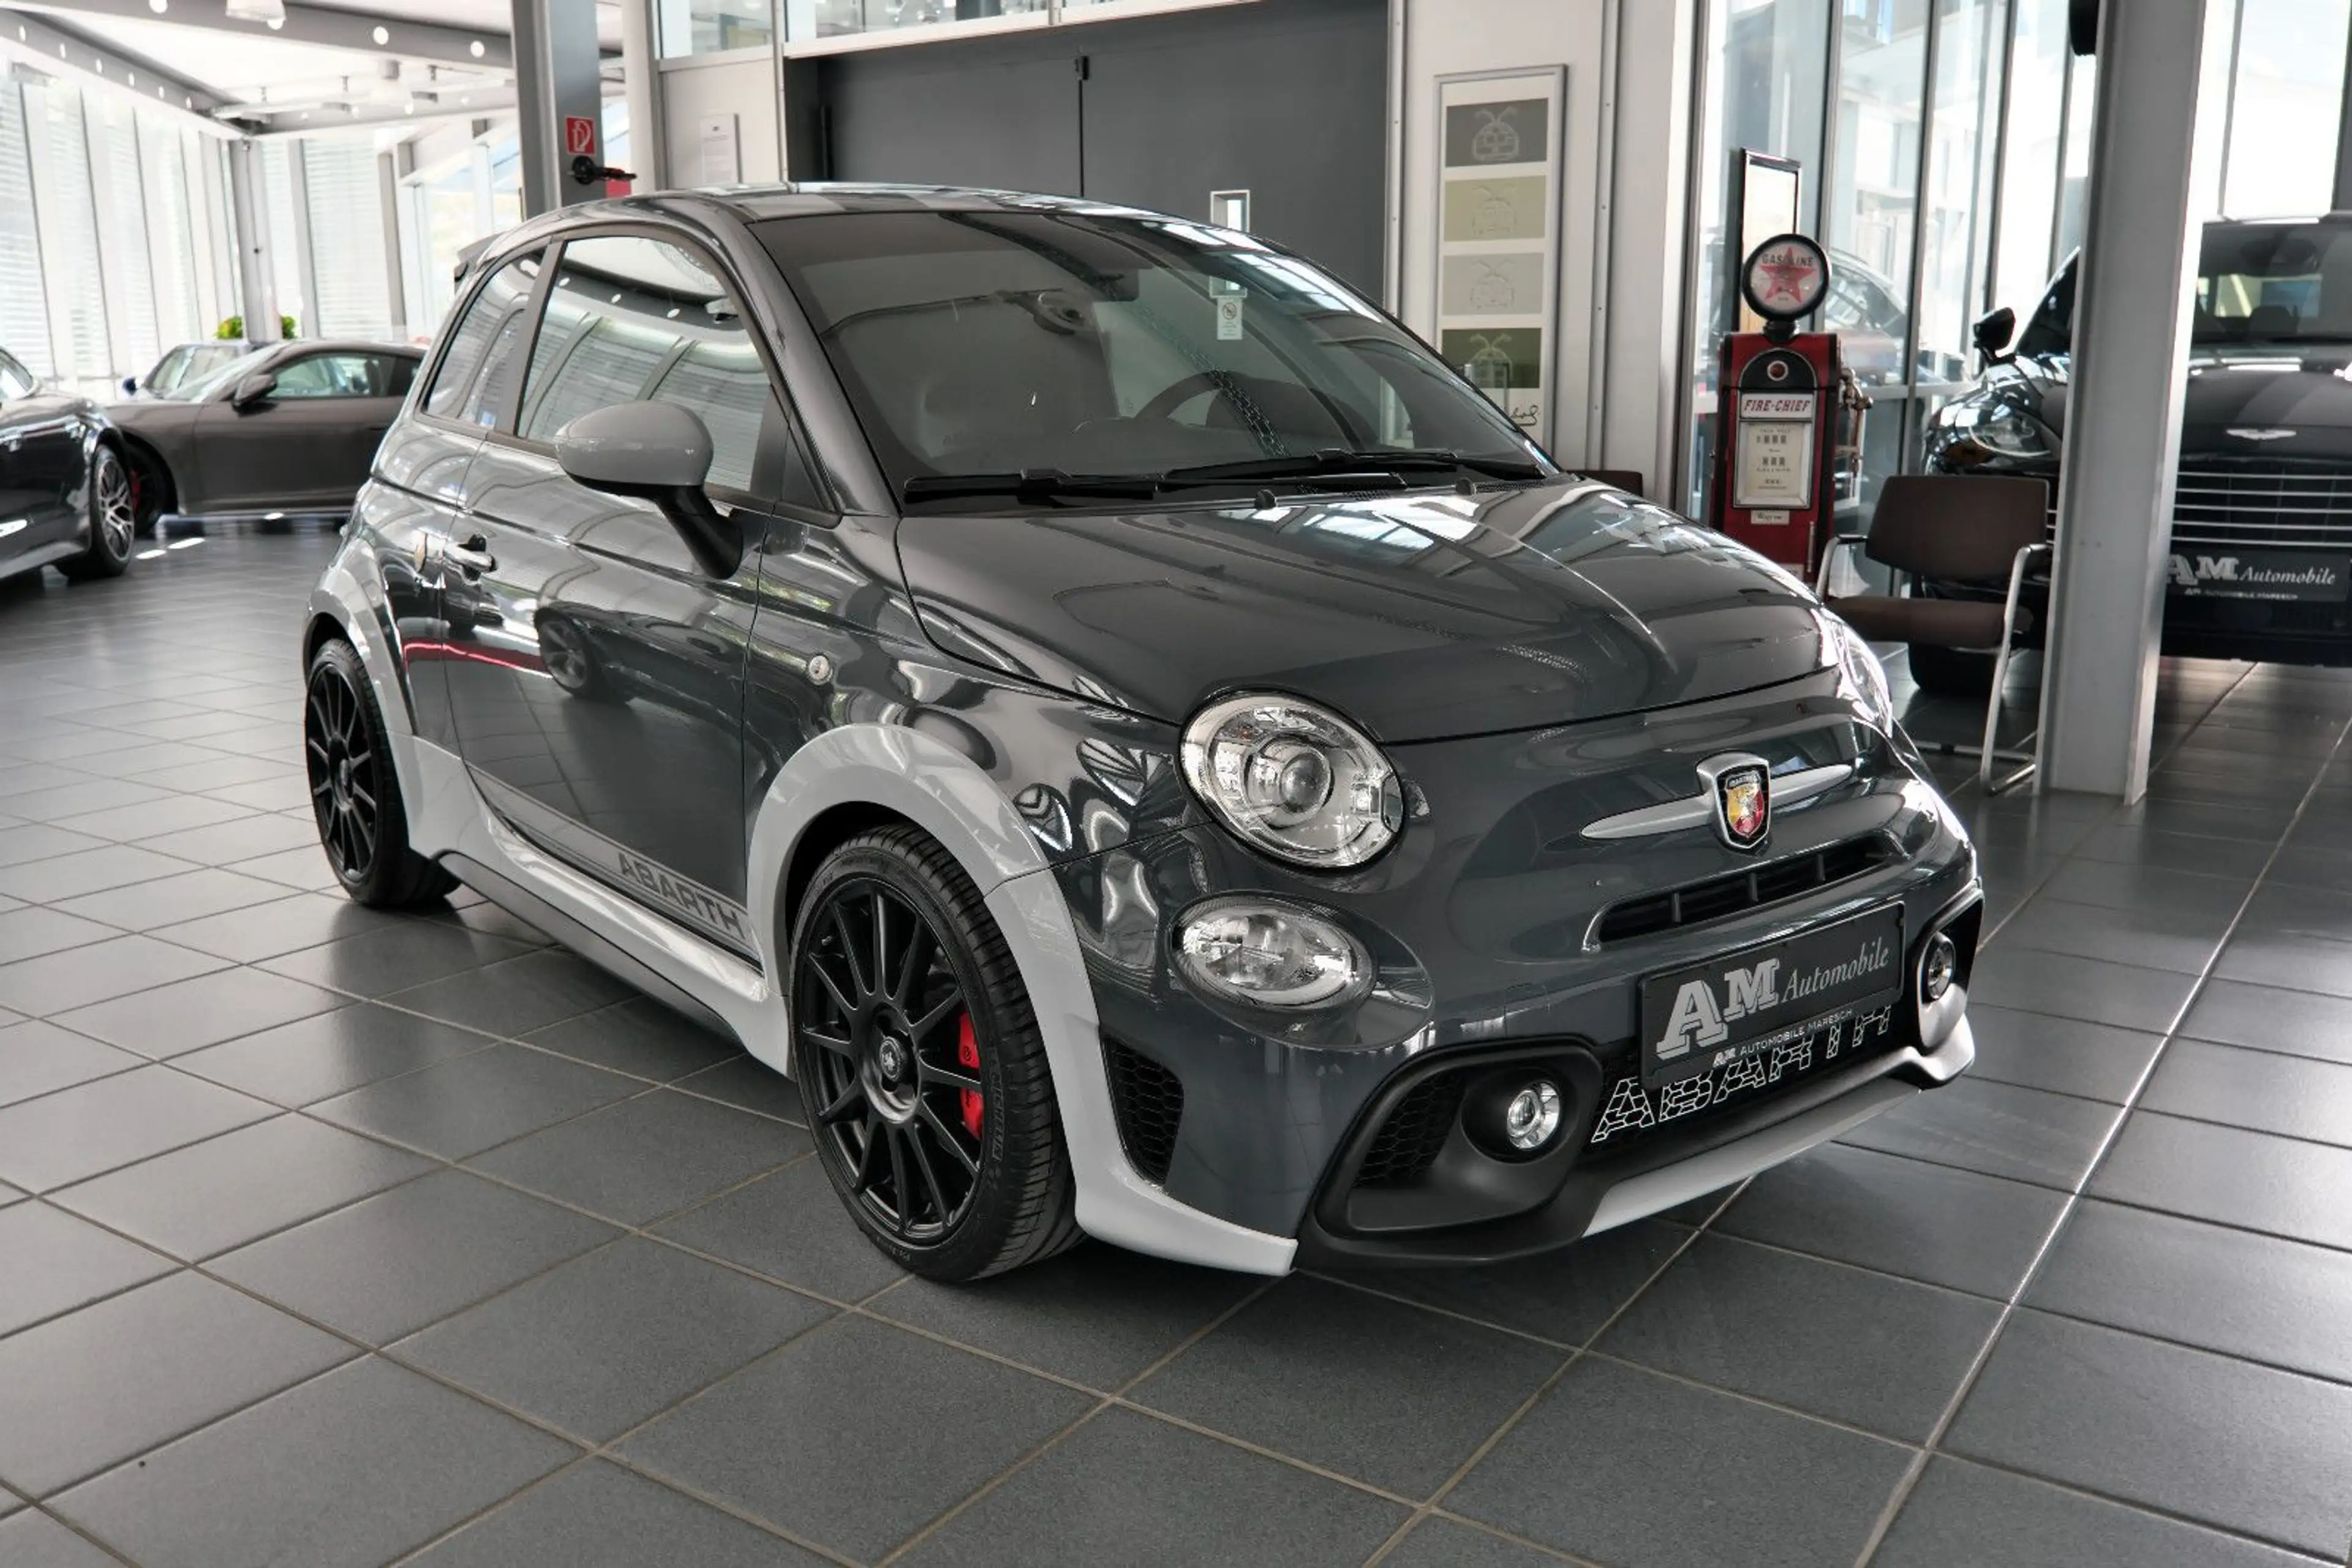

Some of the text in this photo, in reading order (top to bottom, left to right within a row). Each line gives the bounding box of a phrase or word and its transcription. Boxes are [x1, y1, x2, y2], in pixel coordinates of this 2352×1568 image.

[2239, 566, 2335, 585] Automobile
[618, 852, 746, 940] ABARTH
[1656, 936, 1890, 1060] AM Automobile
[1740, 1026, 1806, 1057] AUTOMOBILE
[1807, 1009, 1852, 1032] MARESCH
